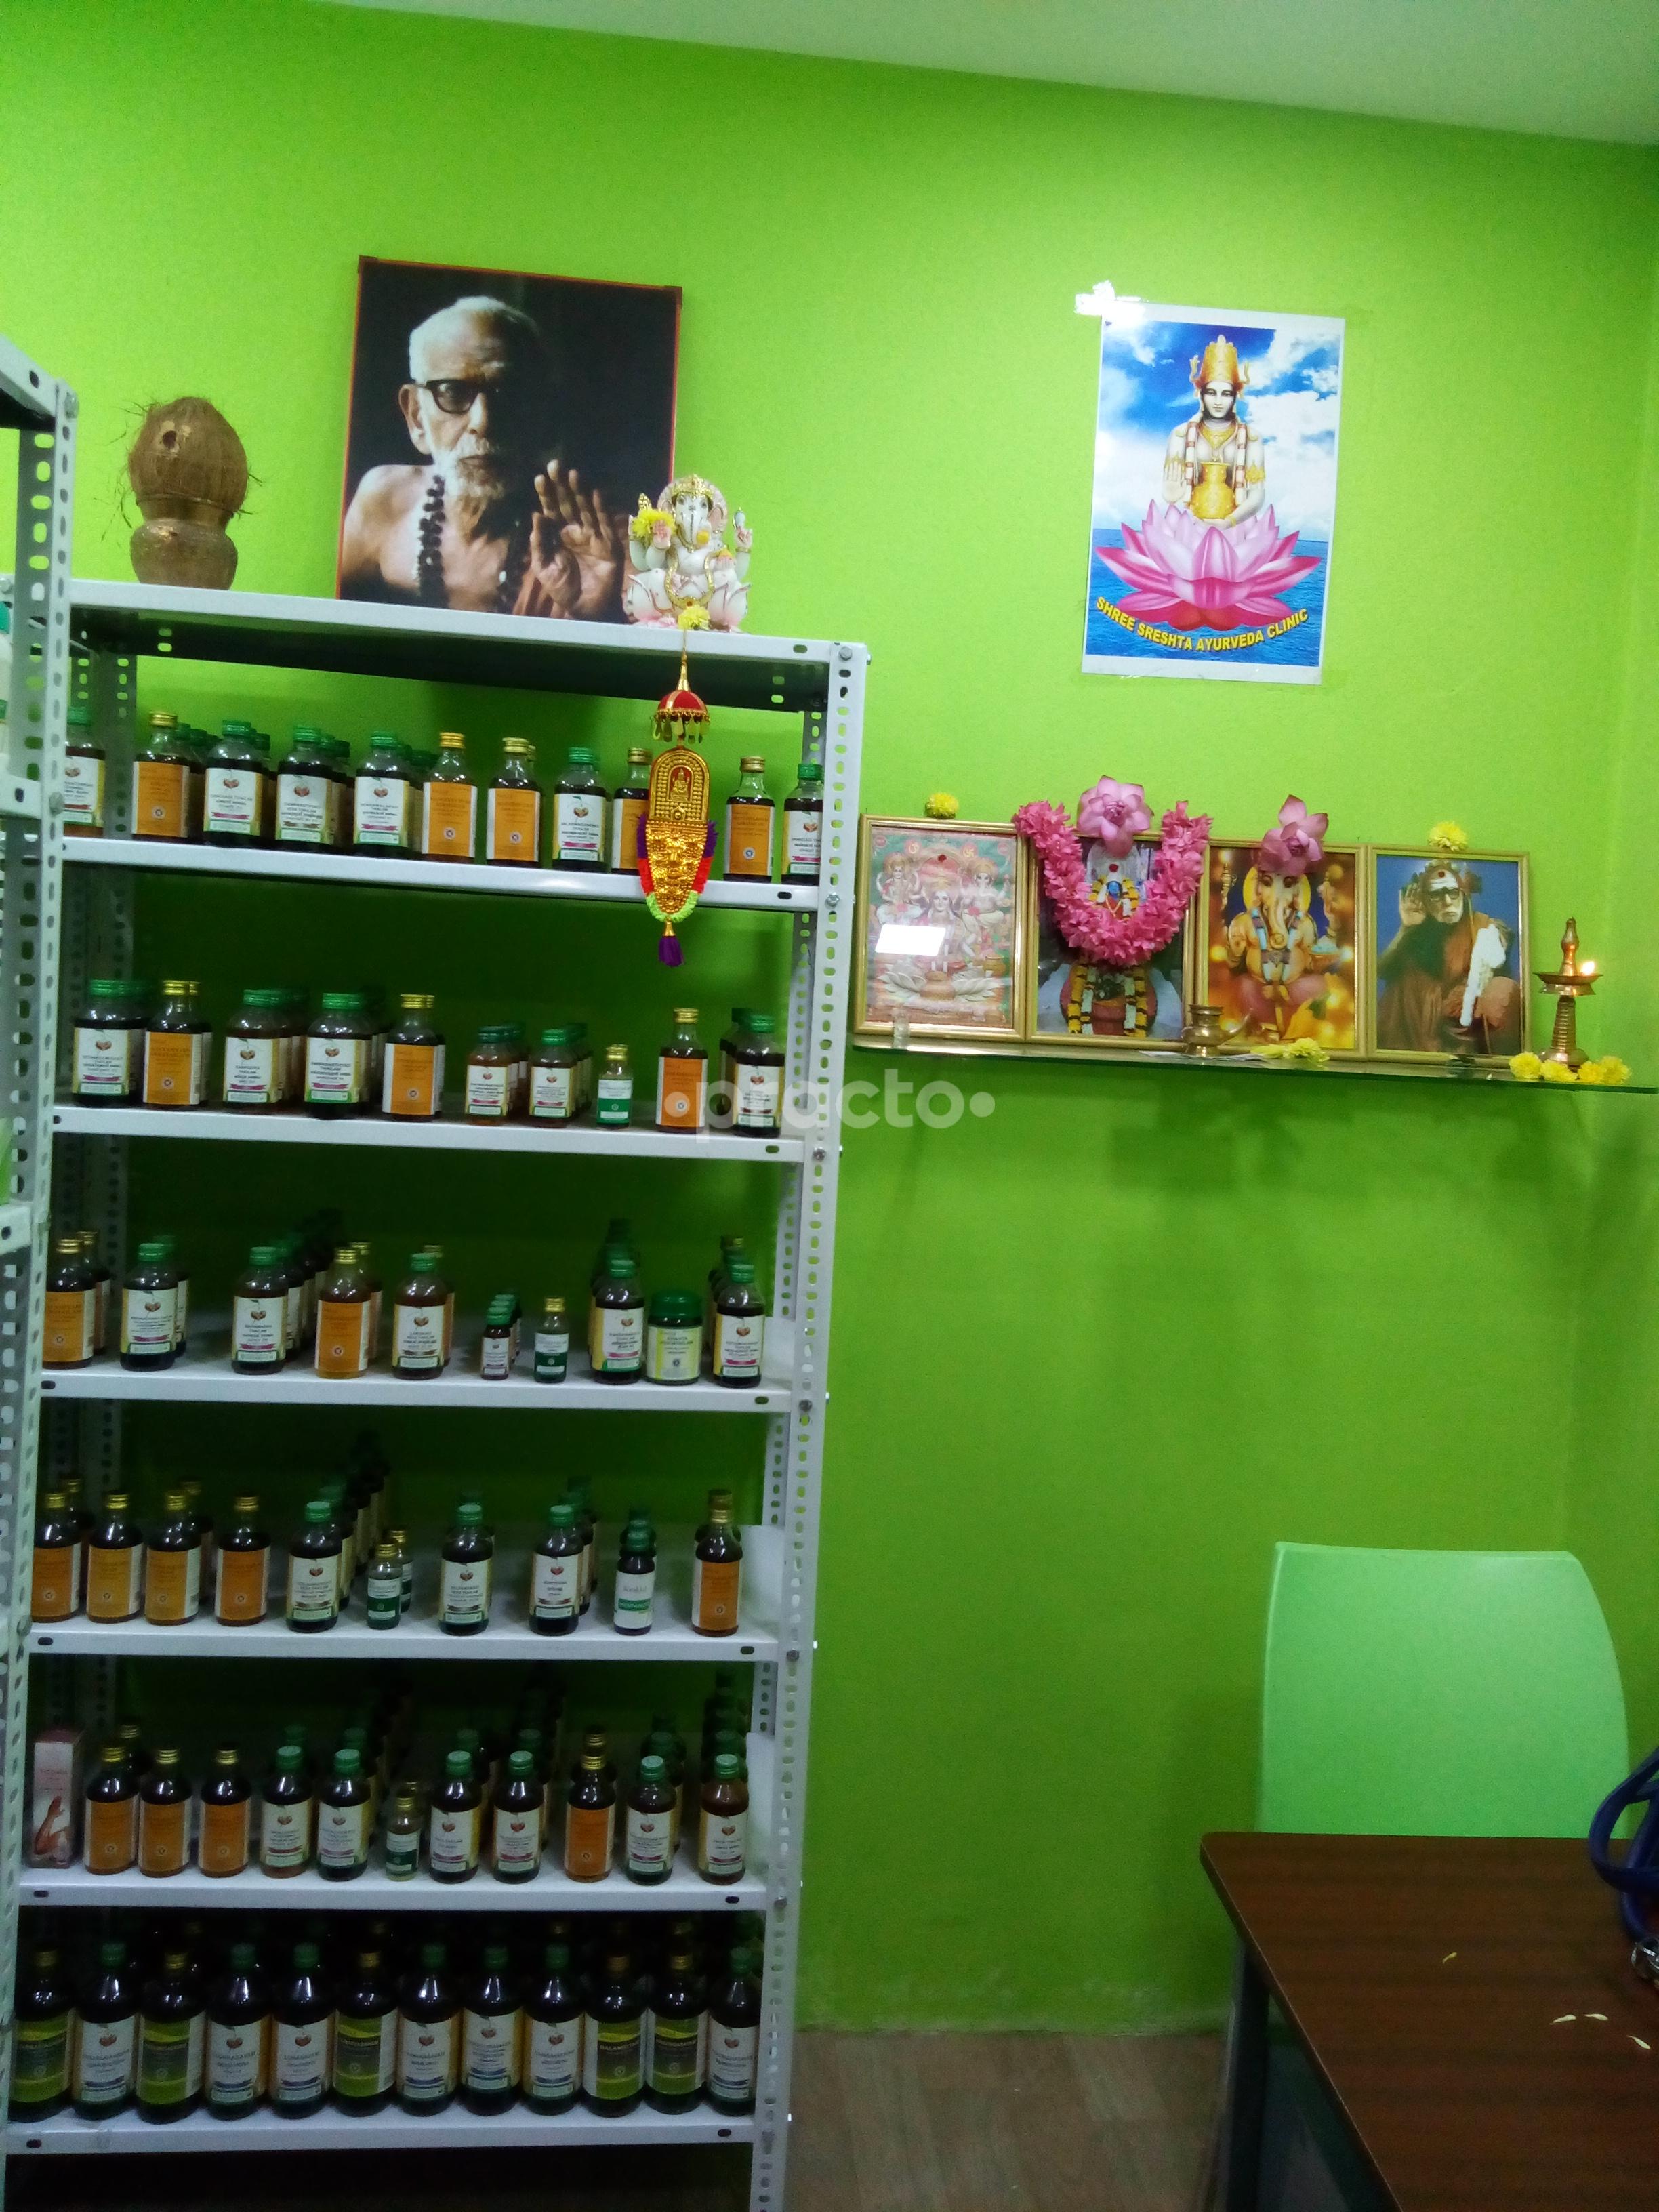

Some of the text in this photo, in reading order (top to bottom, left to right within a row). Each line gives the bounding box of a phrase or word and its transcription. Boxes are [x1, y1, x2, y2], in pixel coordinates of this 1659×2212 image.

[1097, 596, 1309, 651] SHREE SRESHTA AYURVEDA CLINIC
